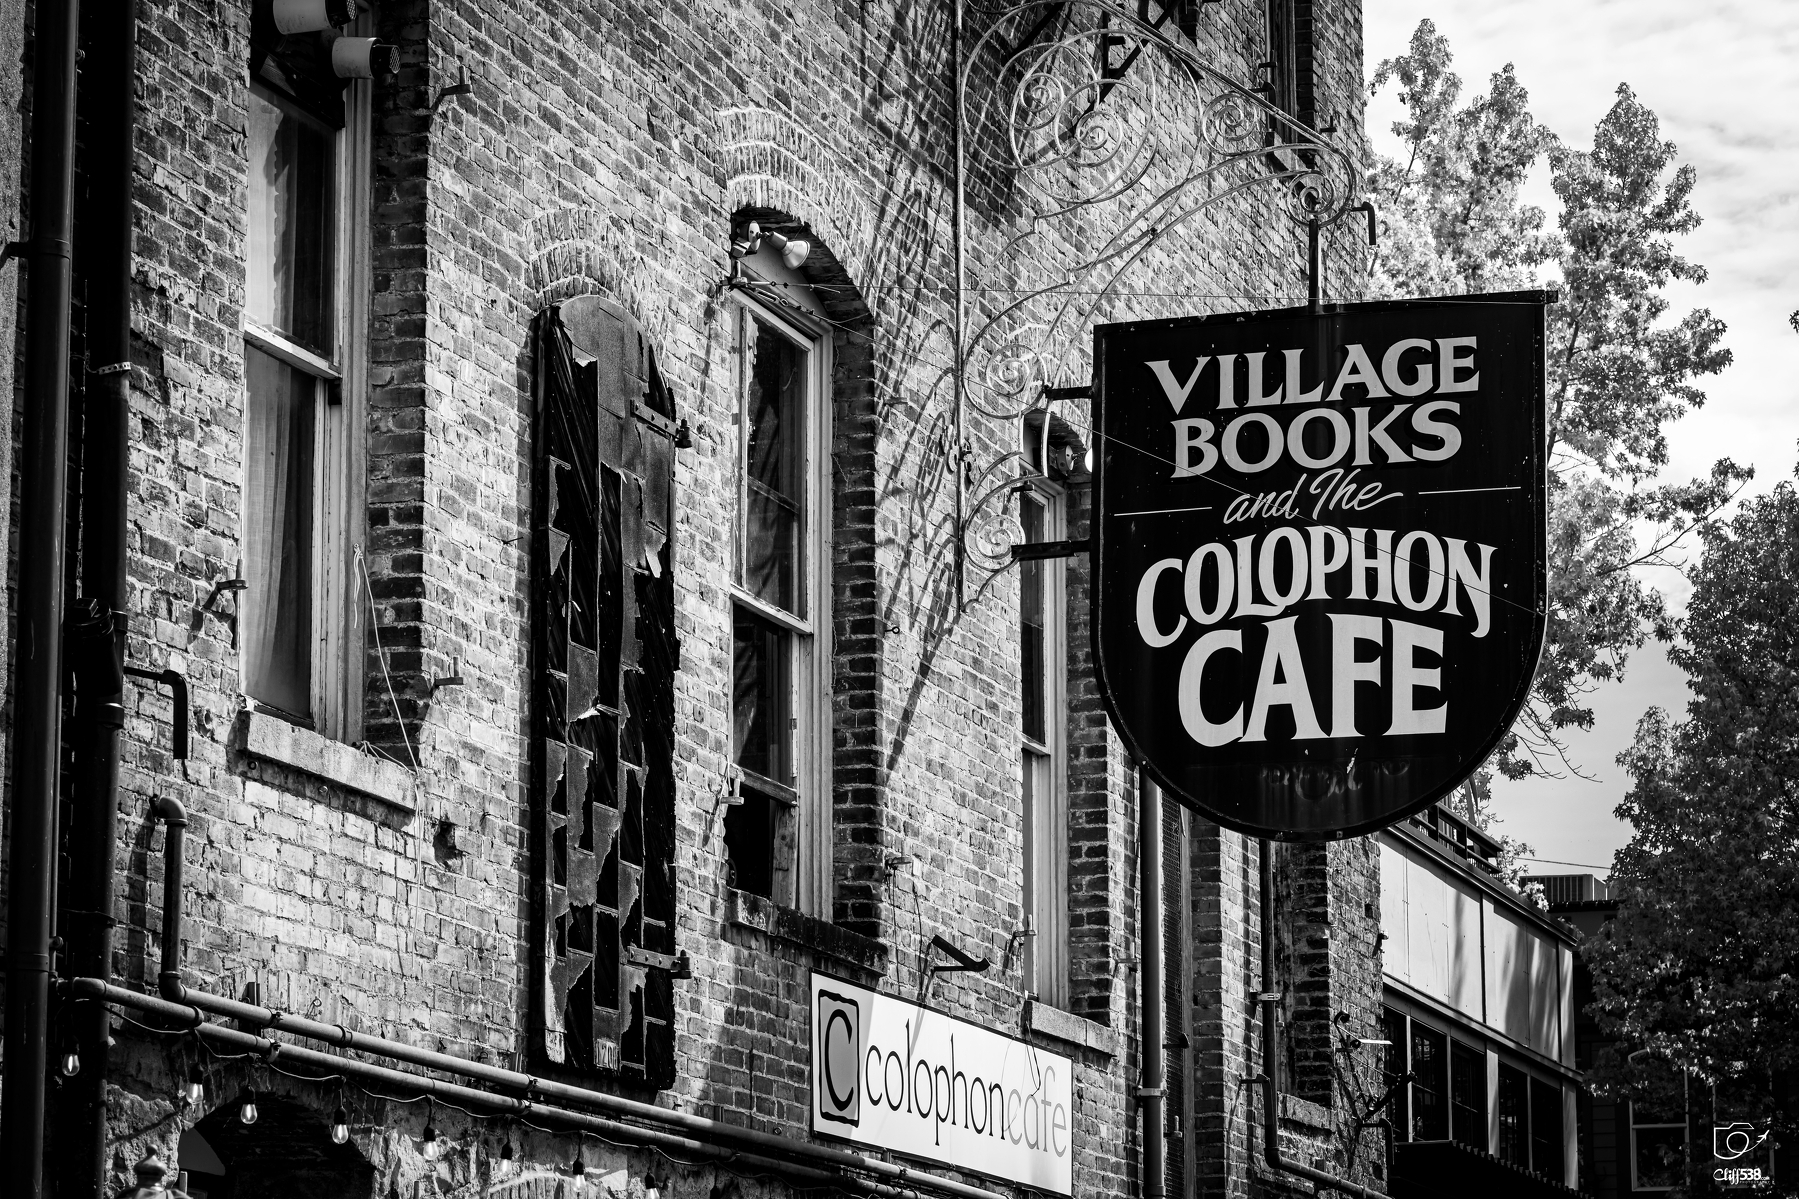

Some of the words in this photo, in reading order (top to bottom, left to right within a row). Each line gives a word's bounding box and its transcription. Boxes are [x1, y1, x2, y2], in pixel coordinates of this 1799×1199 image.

[1144, 336, 1480, 415] VILLAGE
[1170, 401, 1462, 479] BOOKS
[1223, 472, 1306, 525] and
[1309, 468, 1404, 521] The
[1135, 526, 1498, 648] COLOPHON
[1178, 613, 1448, 748] CAFE
[824, 1008, 854, 1112] C
